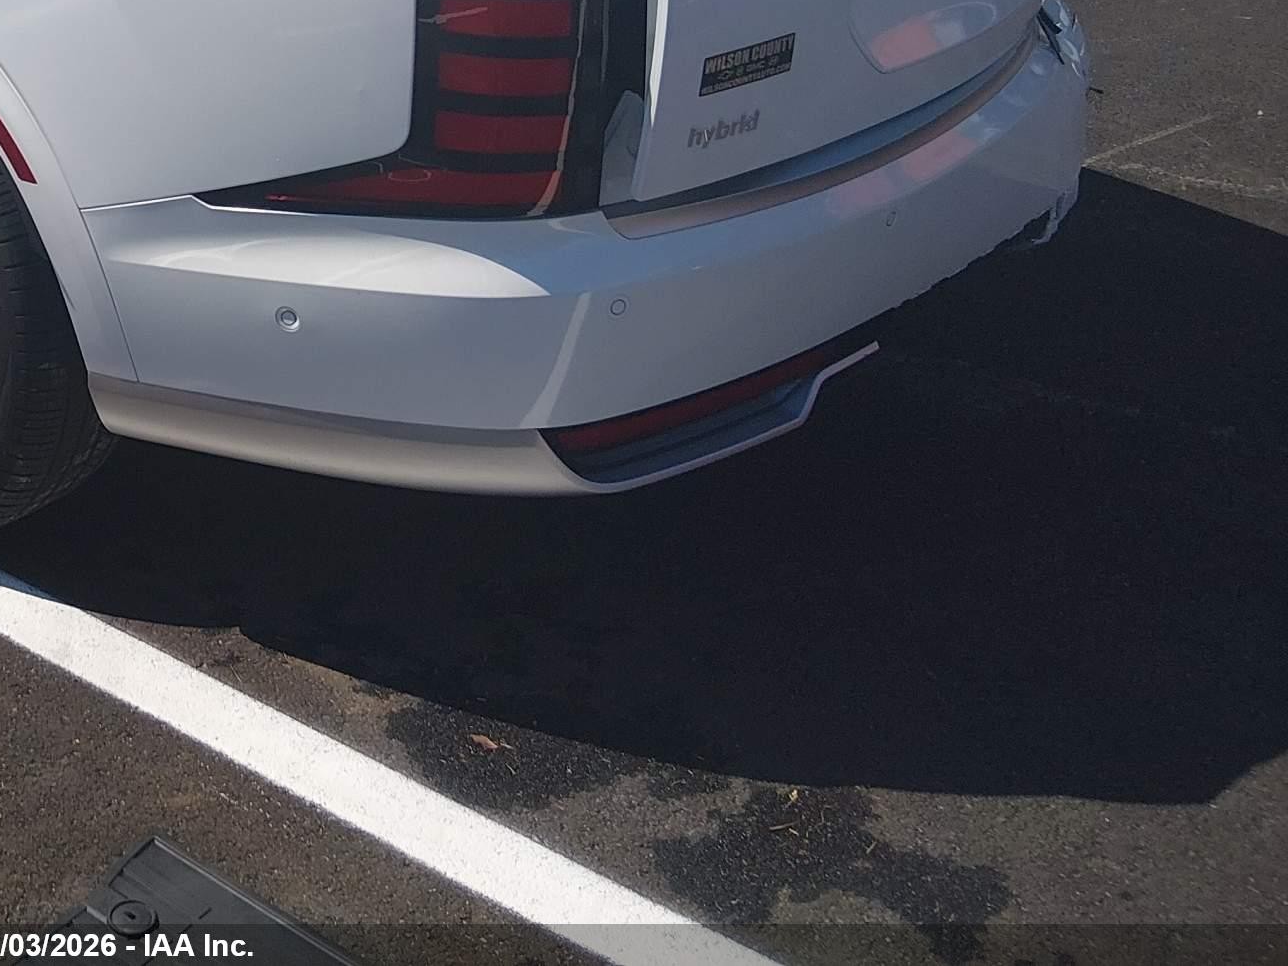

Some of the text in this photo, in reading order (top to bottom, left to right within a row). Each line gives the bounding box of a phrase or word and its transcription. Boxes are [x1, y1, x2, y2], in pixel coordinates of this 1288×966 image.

[704, 48, 750, 74] WILSON
[751, 35, 794, 60] COUNTY
[687, 108, 760, 149] hybrid
